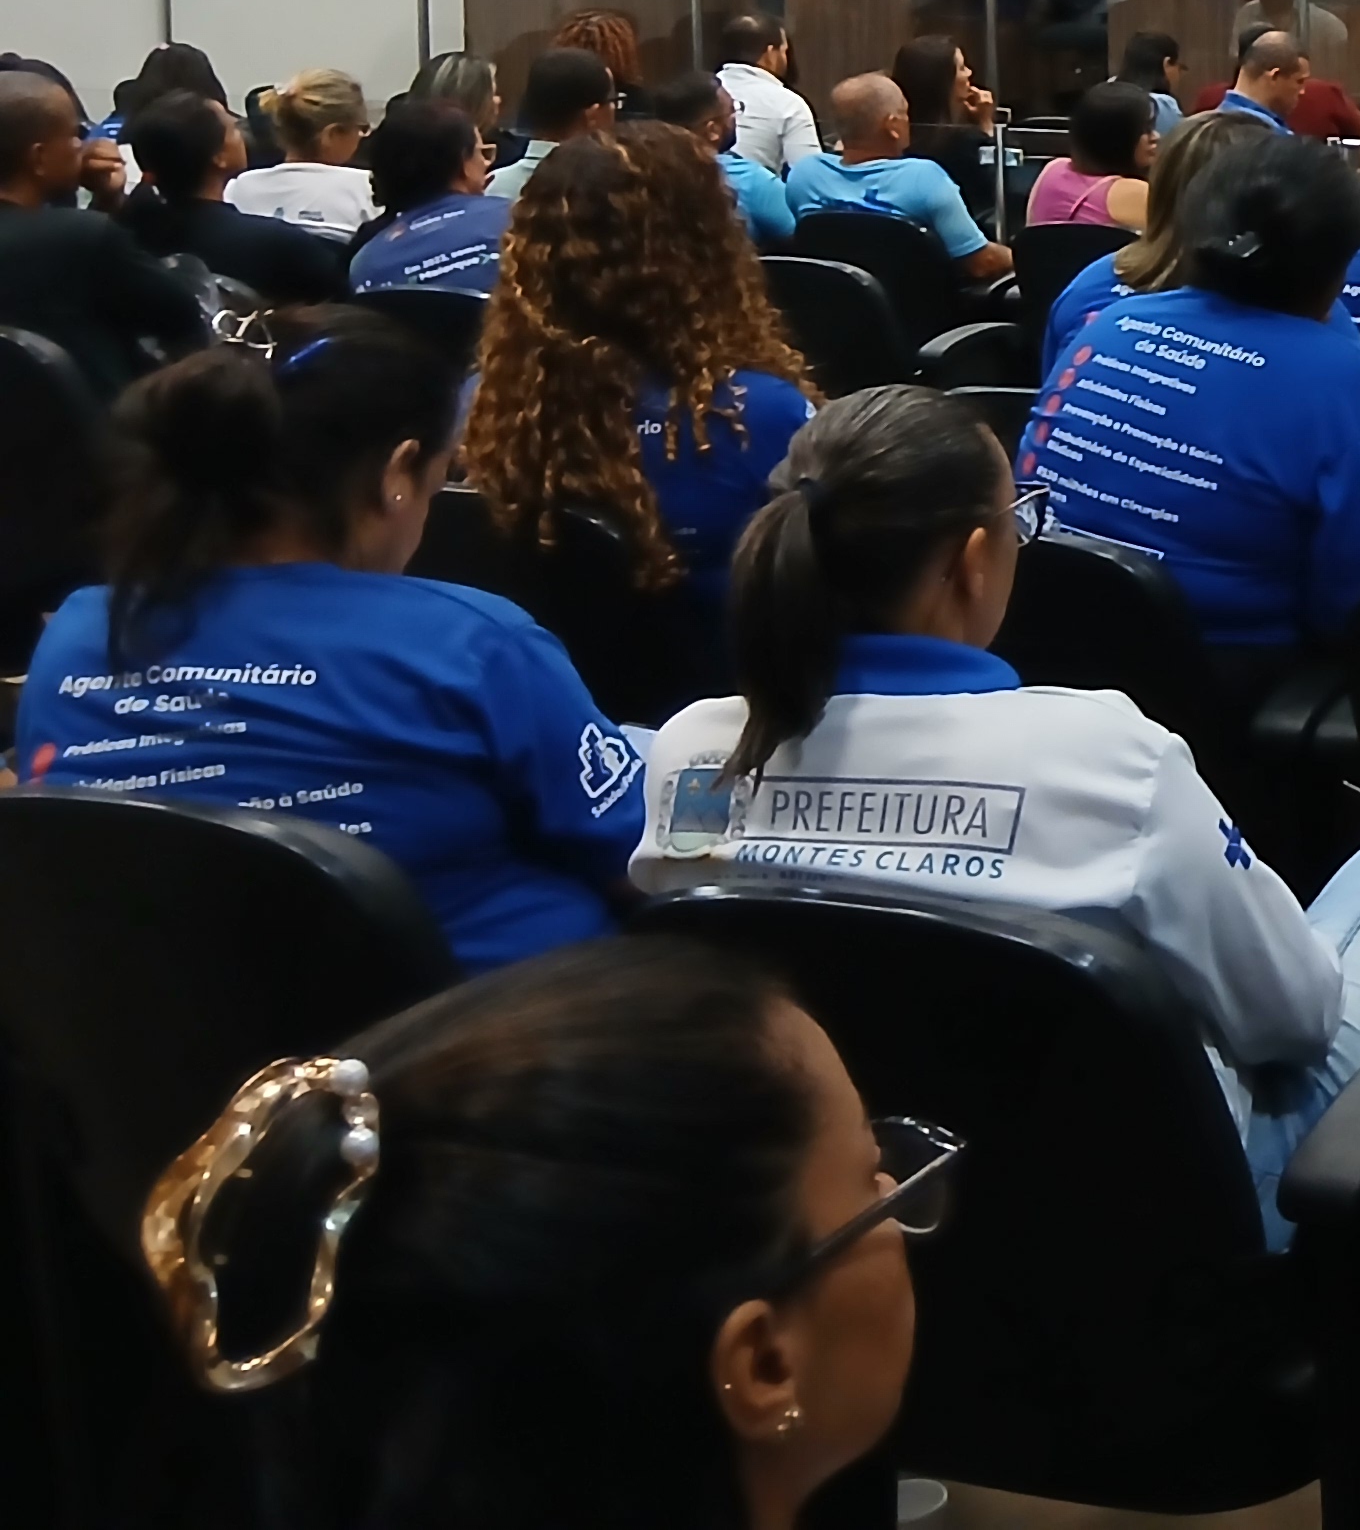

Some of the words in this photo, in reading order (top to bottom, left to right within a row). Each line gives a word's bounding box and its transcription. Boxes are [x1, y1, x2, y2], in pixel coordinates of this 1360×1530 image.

[1134, 338, 1154, 354] de
[1155, 344, 1207, 370] Saúde
[1161, 326, 1266, 368] Comunitário
[146, 663, 317, 686] Comunitário
[114, 695, 149, 714] de
[296, 782, 364, 804] Saúde
[770, 790, 988, 838] PREFEITURA
[735, 844, 866, 867] MONTES
[875, 851, 1005, 879] CLAROS
